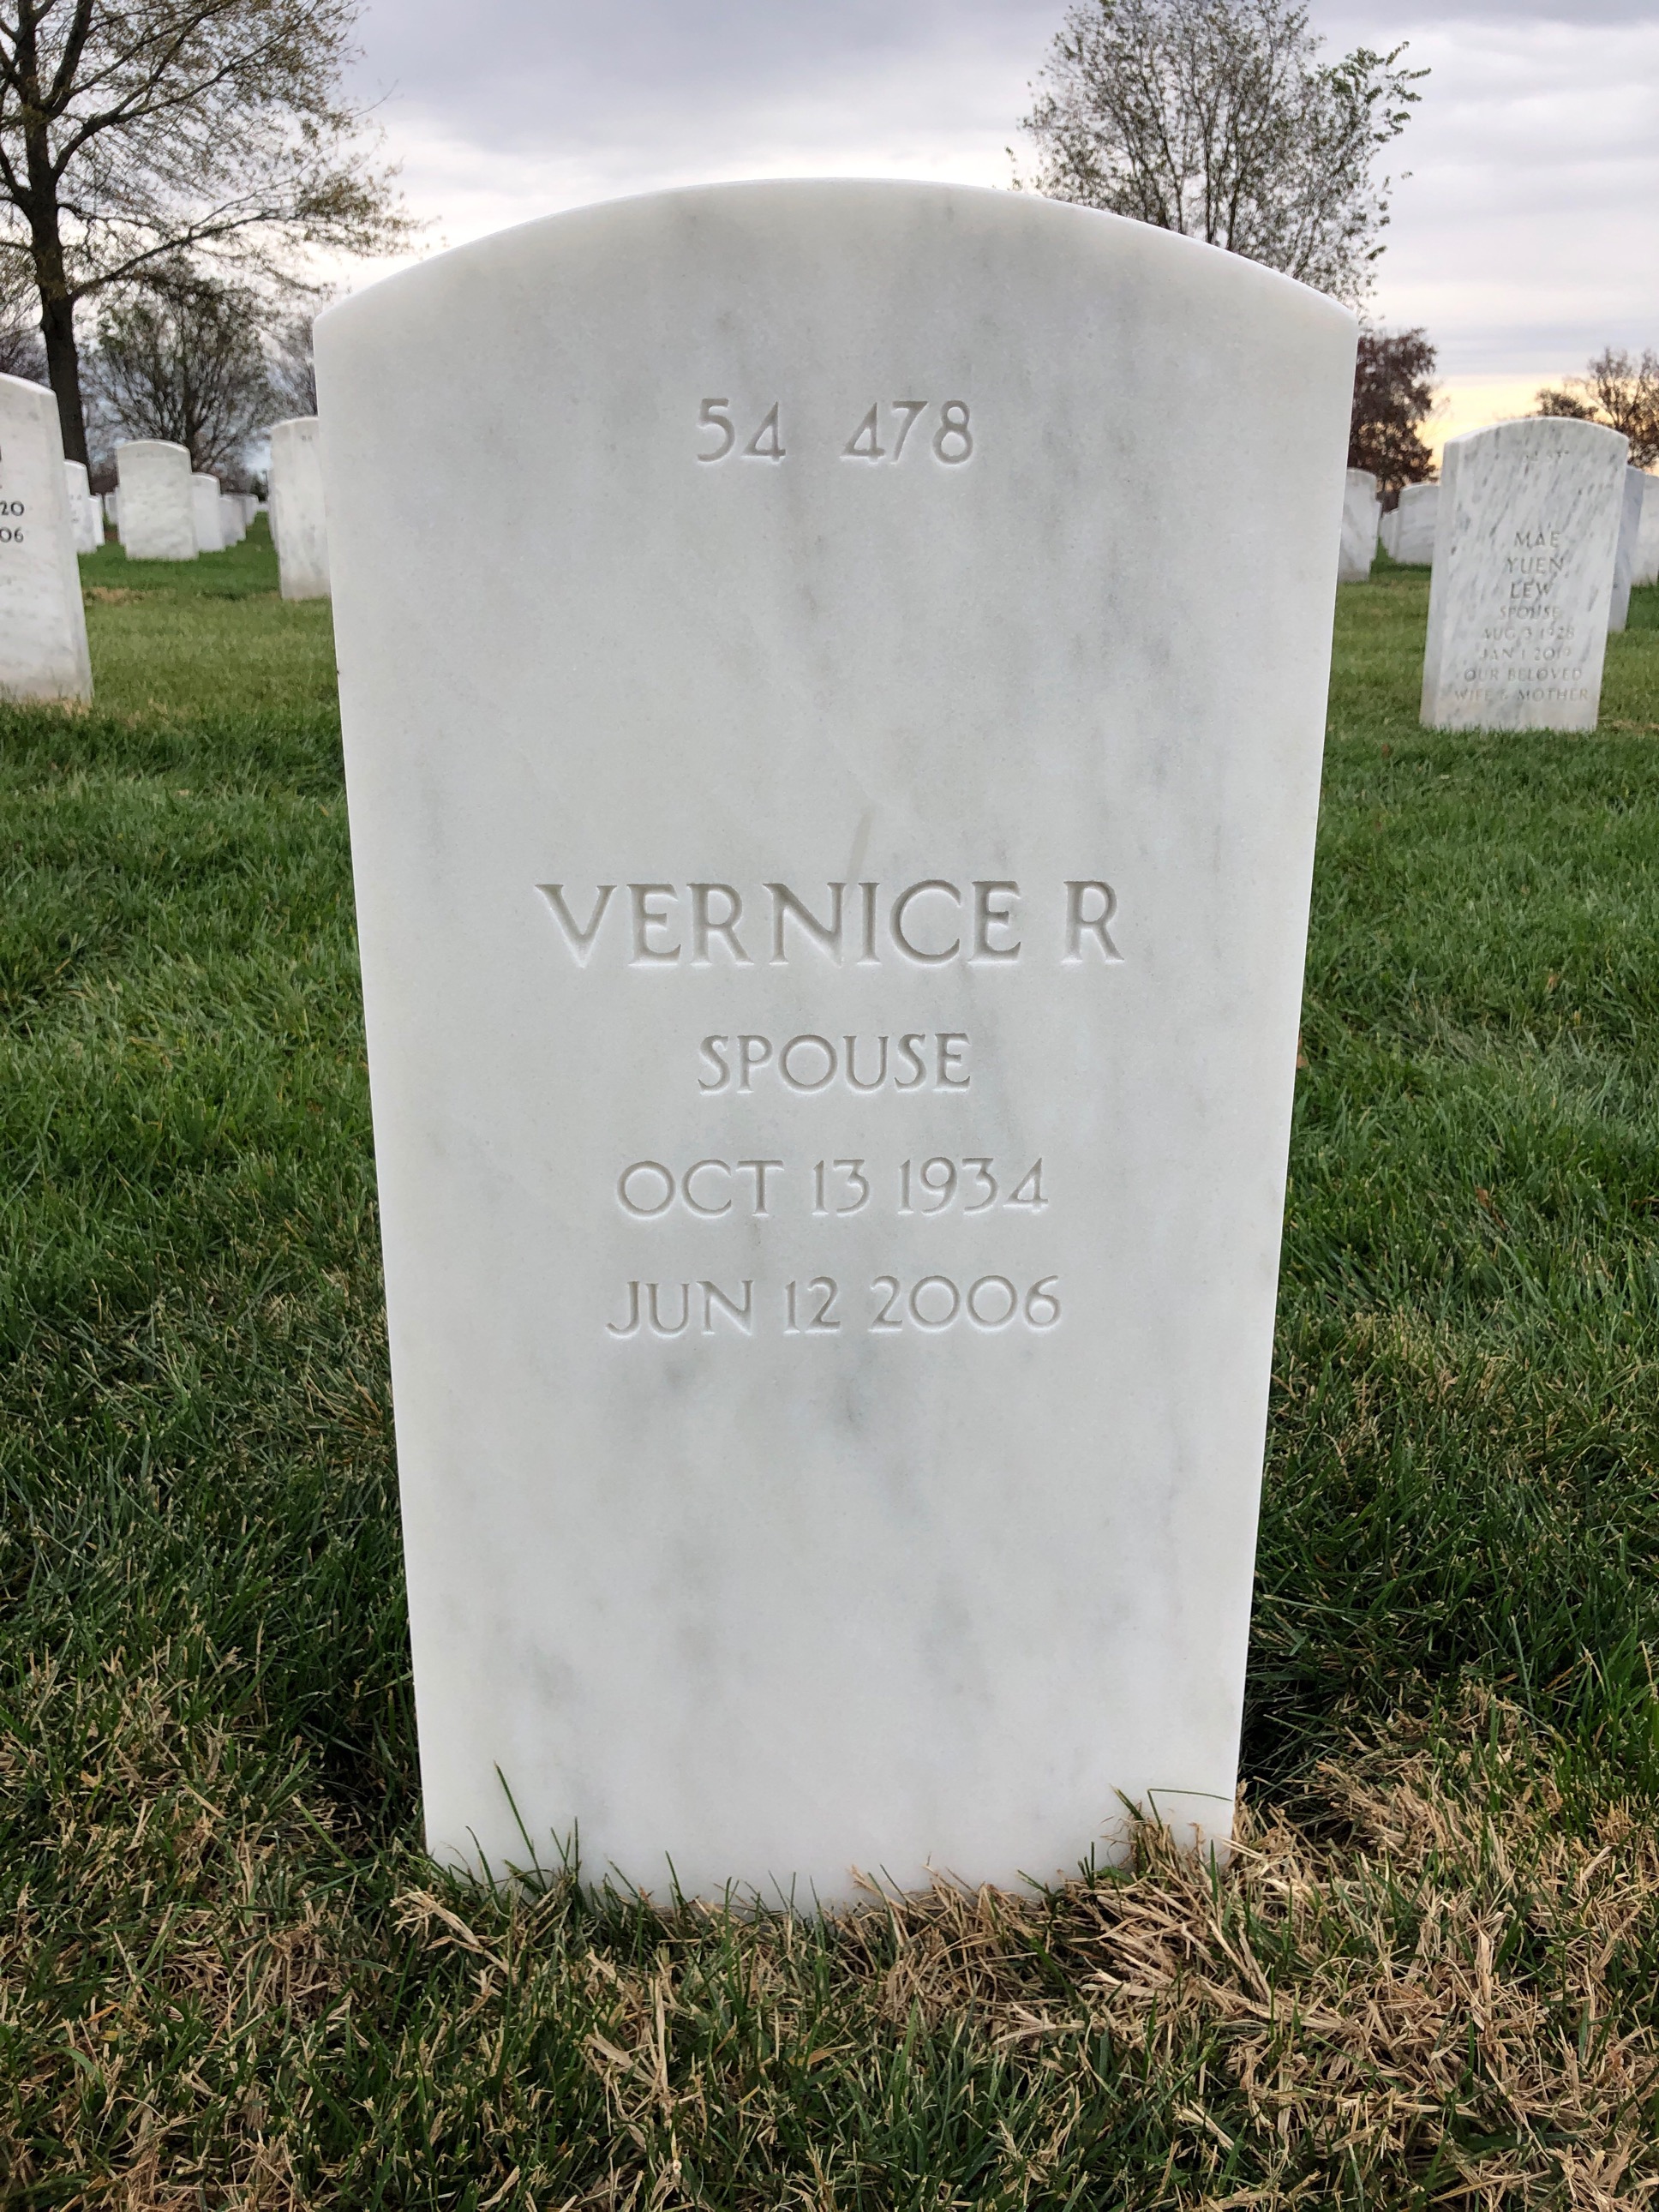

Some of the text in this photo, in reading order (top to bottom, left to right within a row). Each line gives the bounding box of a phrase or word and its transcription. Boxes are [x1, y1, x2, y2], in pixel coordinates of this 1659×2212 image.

[696, 397, 973, 465] 54 478
[1513, 531, 1561, 549] MAE
[1506, 556, 1565, 574] YUEN
[1510, 581, 1553, 599] LEW
[1499, 604, 1563, 620] SPOUSE
[1464, 666, 1582, 682] OUR BELOVED
[1454, 688, 1493, 702] WIFE
[1517, 687, 1589, 702] MOTHER
[535, 879, 1124, 968] VERNICE R
[697, 1032, 972, 1095] SPOUSE
[615, 1156, 1049, 1219] OCT 13 1934
[605, 1274, 1062, 1337] JUN 12 2006
